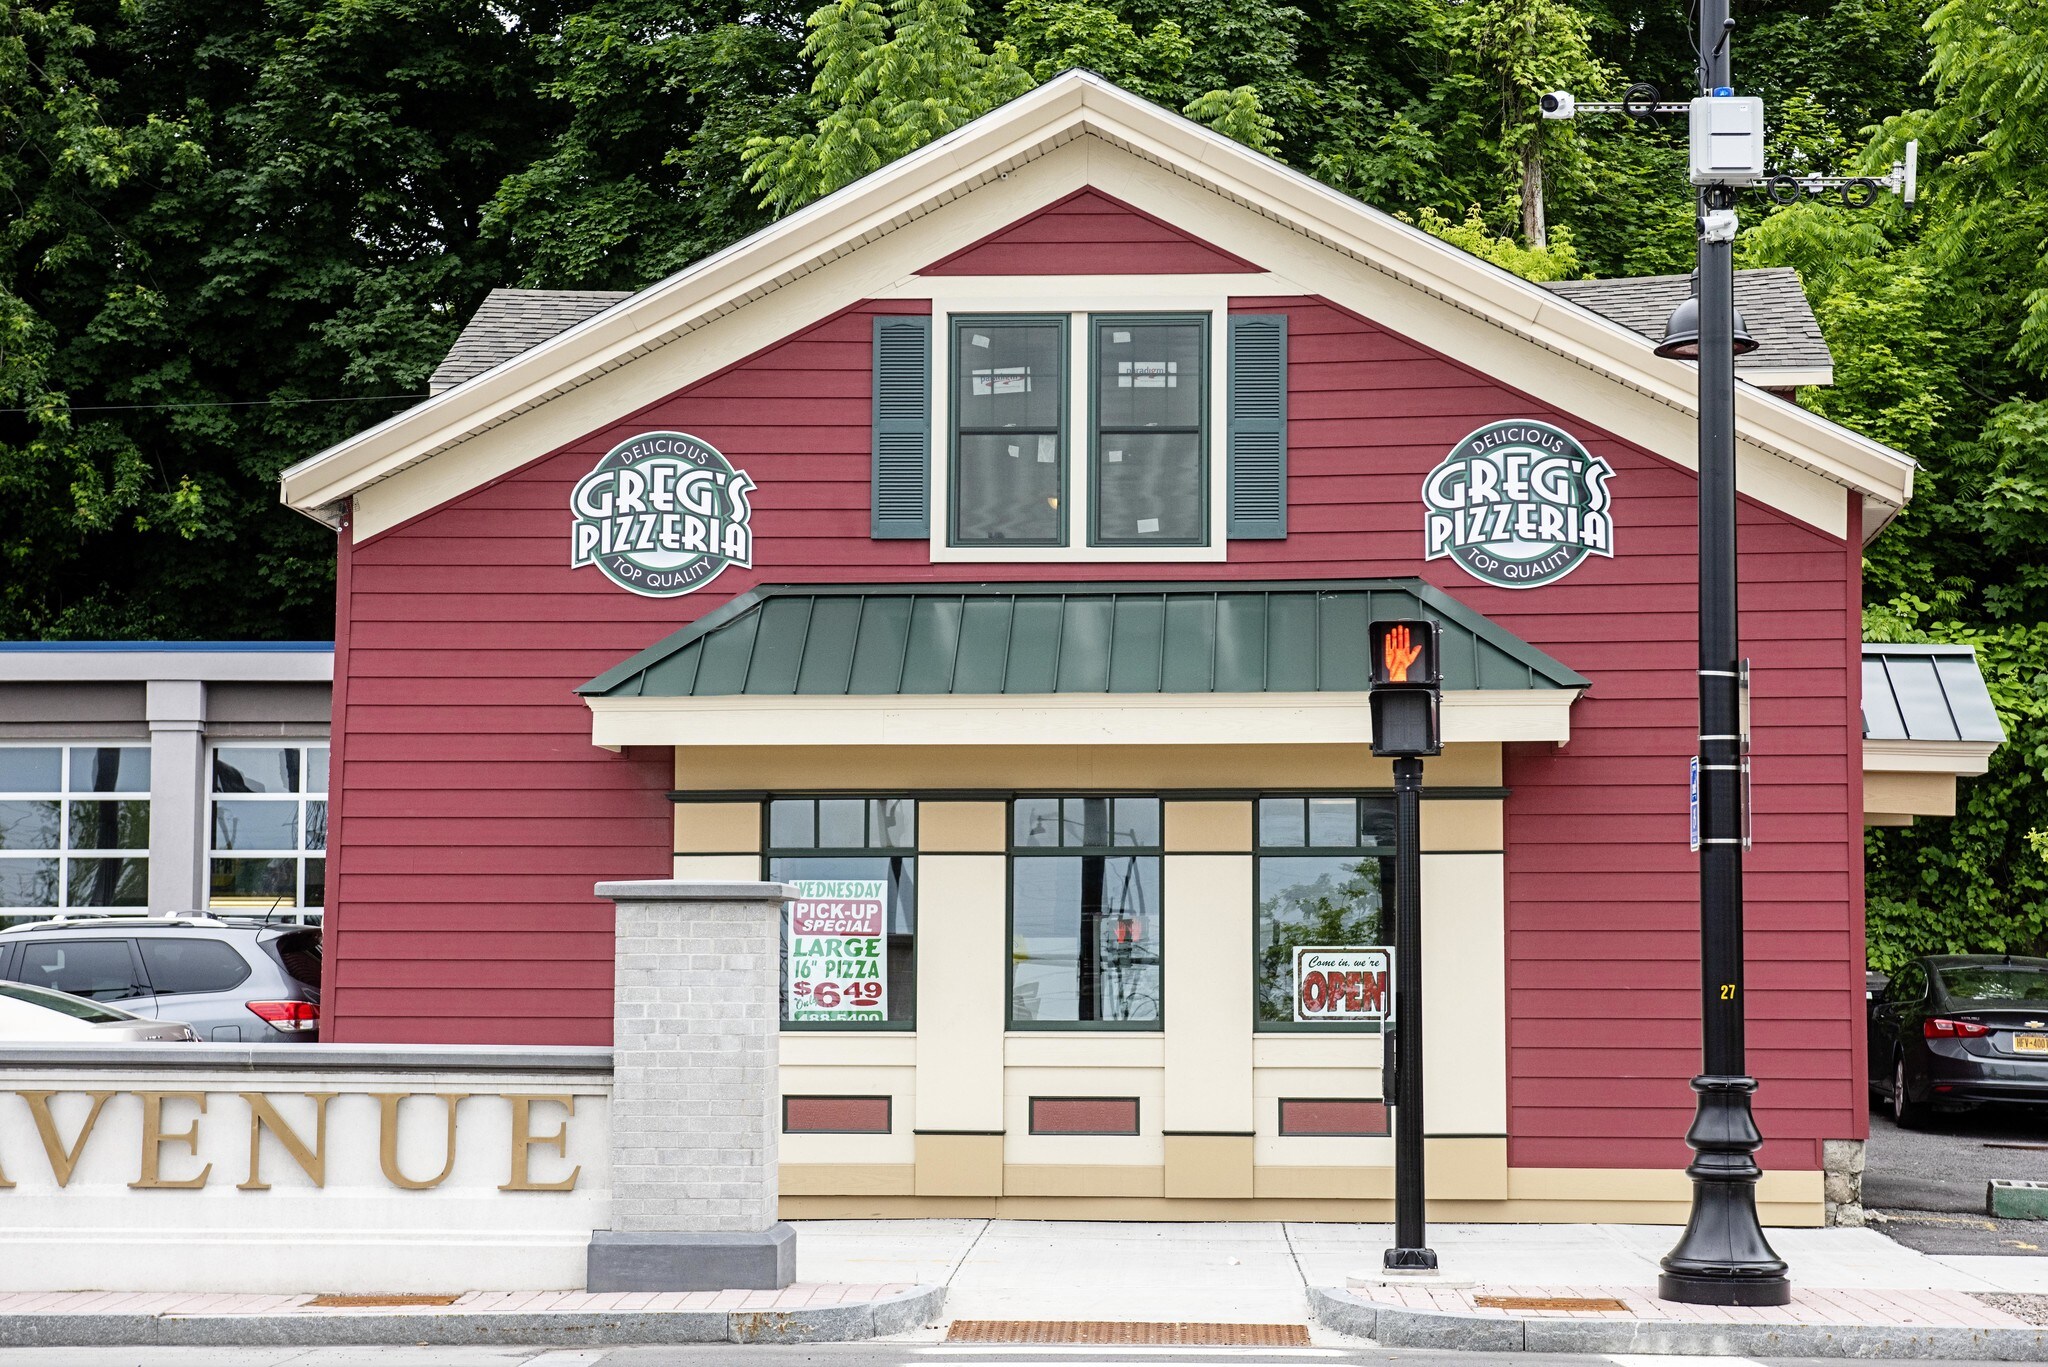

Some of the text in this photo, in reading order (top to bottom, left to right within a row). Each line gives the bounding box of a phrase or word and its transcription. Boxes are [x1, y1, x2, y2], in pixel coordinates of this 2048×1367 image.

[1127, 366, 1164, 376] pradigm
[621, 440, 708, 465] DELICIOUS
[1472, 428, 1563, 454] DELICIOUS
[576, 466, 748, 523] GREG'S
[1427, 456, 1604, 511] GREG'S
[578, 513, 746, 561] PIZZERIA
[1431, 503, 1606, 552] PIZZERIA
[612, 556, 711, 587] TOP QUALITY
[1467, 546, 1570, 578] TOP QUALITY
[794, 882, 882, 898] WEDNESDAY
[796, 903, 878, 919] PICK-UP
[802, 919, 873, 932] SPECIAL
[793, 938, 882, 958] LARGE
[795, 959, 879, 978] 16" PIZZA
[1308, 956, 1336, 968] Come
[1353, 956, 1380, 967] we're
[1303, 971, 1386, 1012] OPEN
[1720, 984, 1735, 999] 27
[0, 1090, 580, 1191] VENUE
